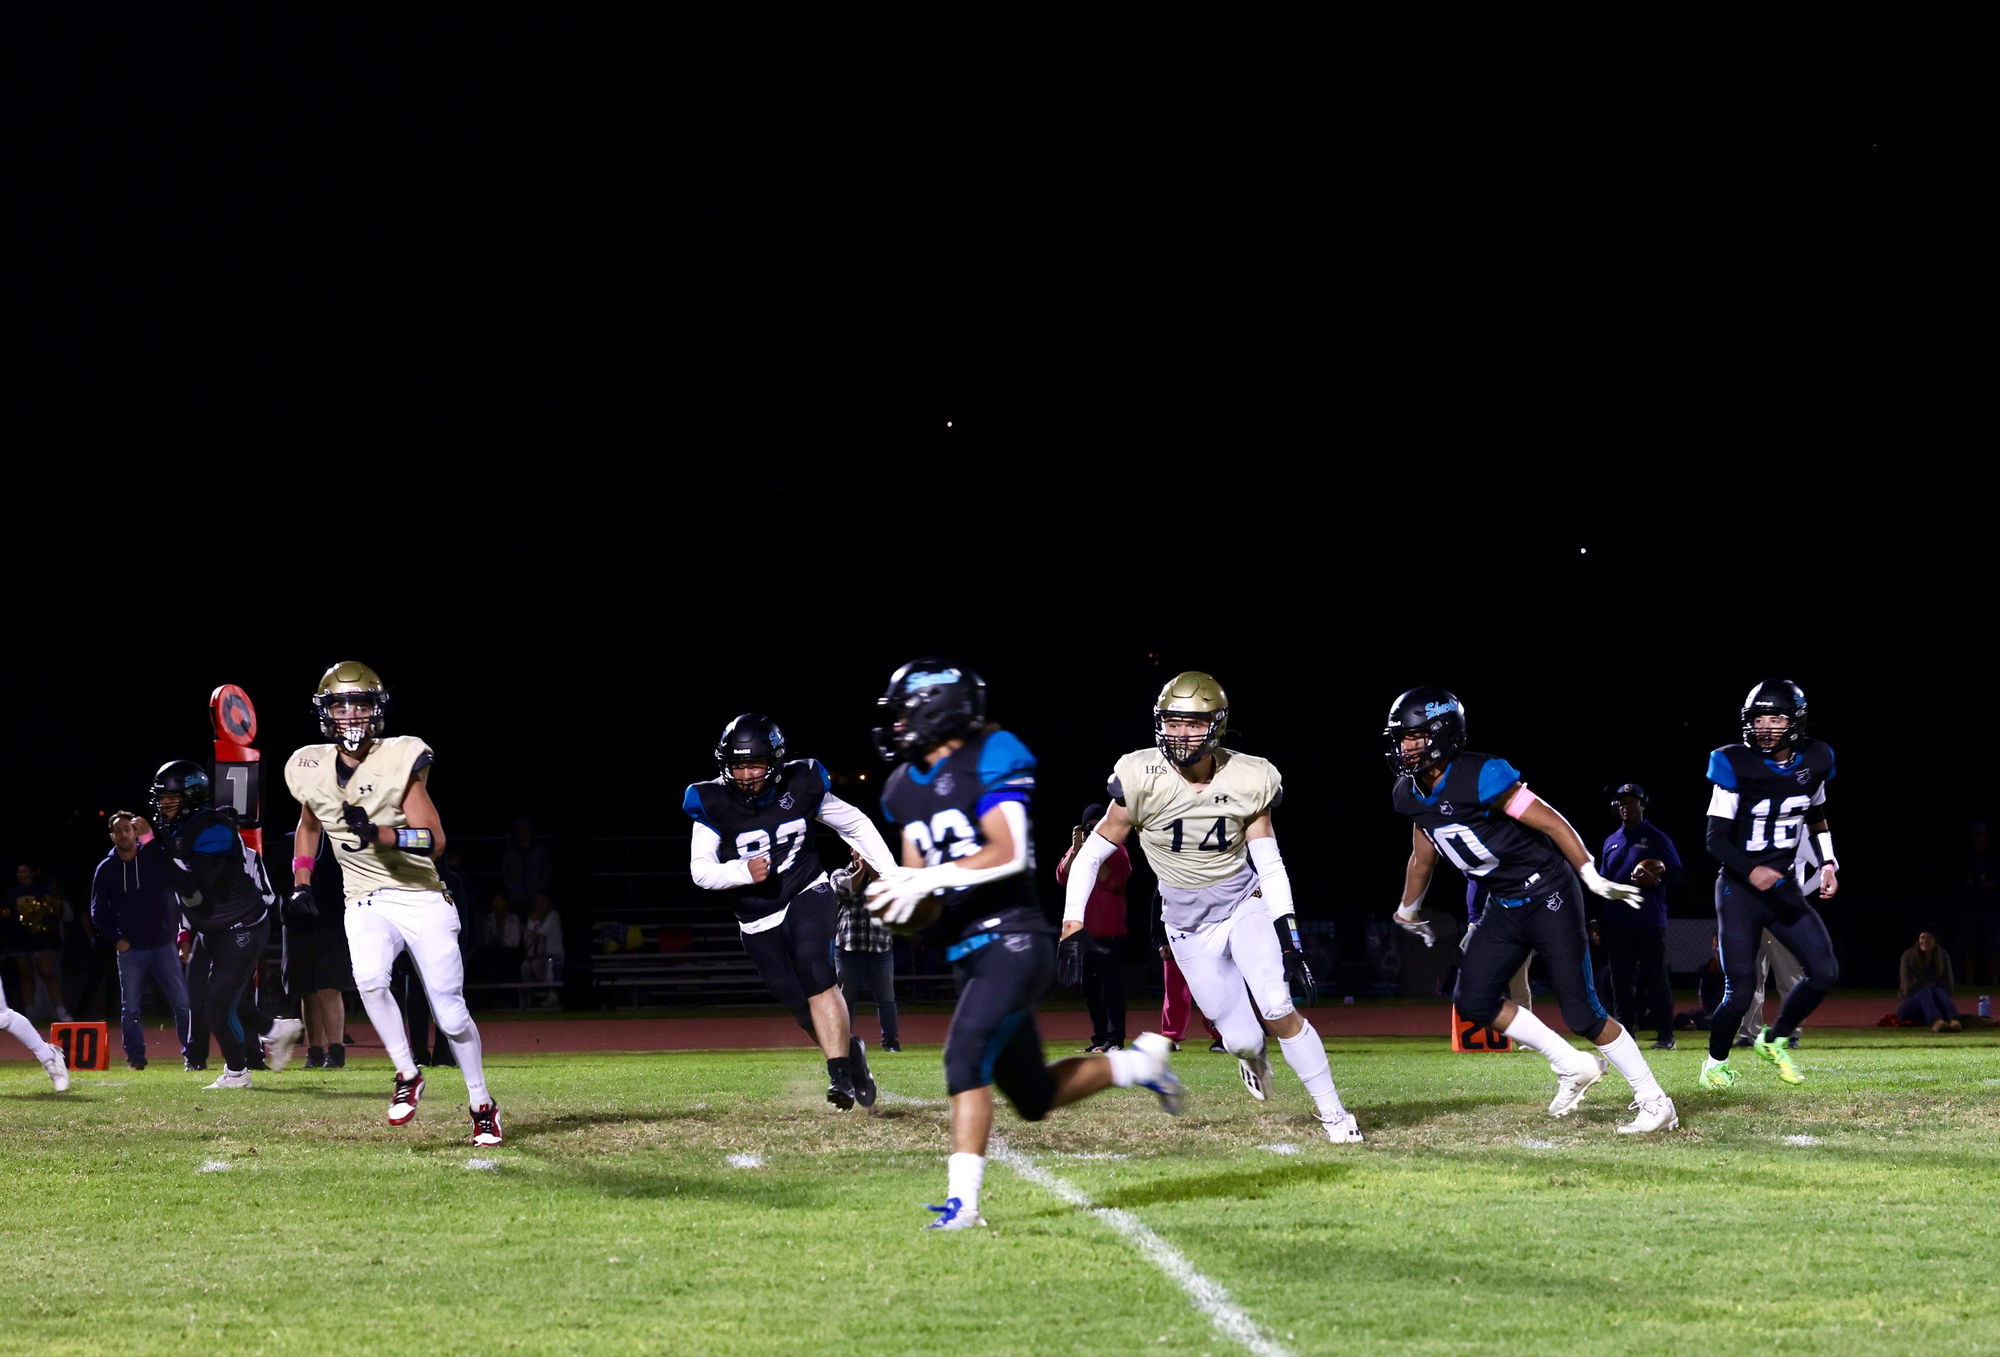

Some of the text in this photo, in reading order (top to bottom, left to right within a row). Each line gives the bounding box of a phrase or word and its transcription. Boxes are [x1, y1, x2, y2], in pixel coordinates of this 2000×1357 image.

[299, 758, 319, 769] HCS
[1145, 765, 1168, 774] HCS
[226, 766, 248, 815] 1
[1162, 816, 1232, 852] 14
[1746, 795, 1811, 851] 16
[1423, 823, 1500, 876] 0
[58, 1027, 98, 1069] 10
